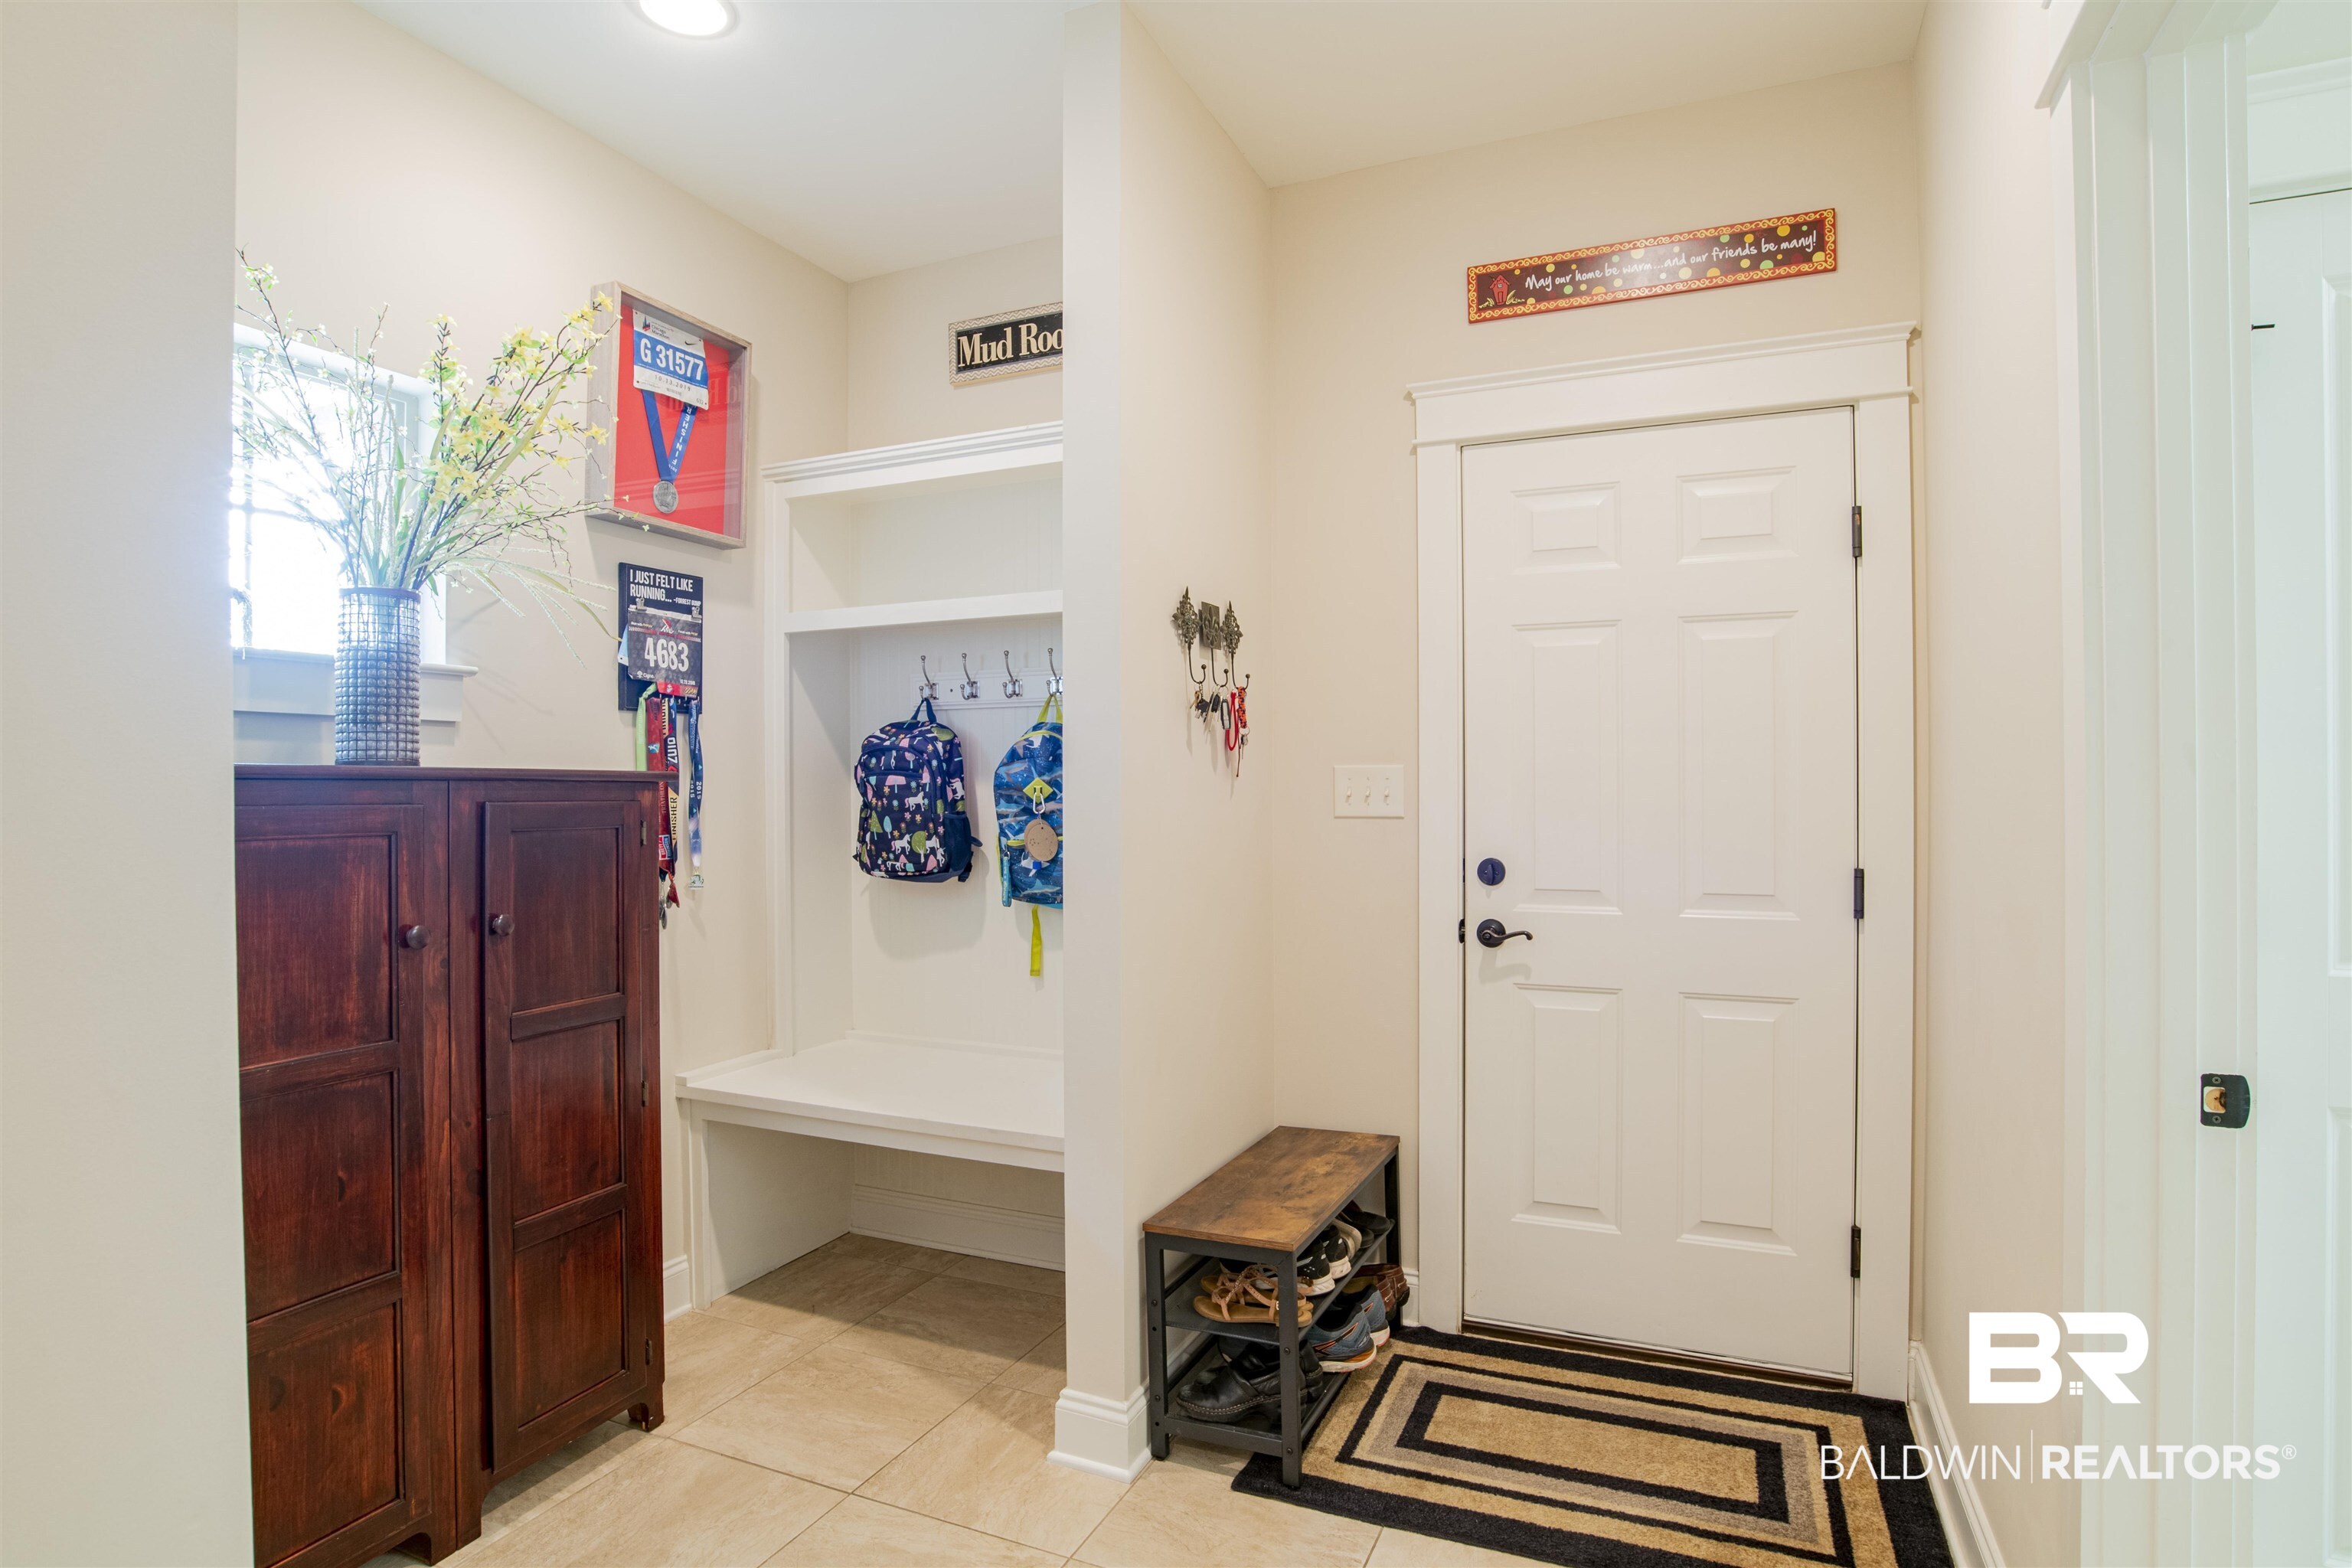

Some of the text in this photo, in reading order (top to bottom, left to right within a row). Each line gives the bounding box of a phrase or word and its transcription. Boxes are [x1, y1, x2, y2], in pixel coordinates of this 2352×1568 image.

[1525, 274, 1552, 292] May
[1555, 274, 1573, 285] our
[1575, 270, 1603, 282] home
[1605, 263, 1621, 276] be
[1690, 253, 1708, 263] our
[1711, 243, 1758, 262] friends
[1761, 237, 1778, 253] be
[1781, 230, 1817, 253] many!
[640, 338, 704, 381] G 31577
[958, 326, 1014, 368] Mud
[629, 569, 694, 592] I JUST FELT LIKE
[629, 583, 672, 603] RUNNING...
[644, 637, 689, 672] 4683
